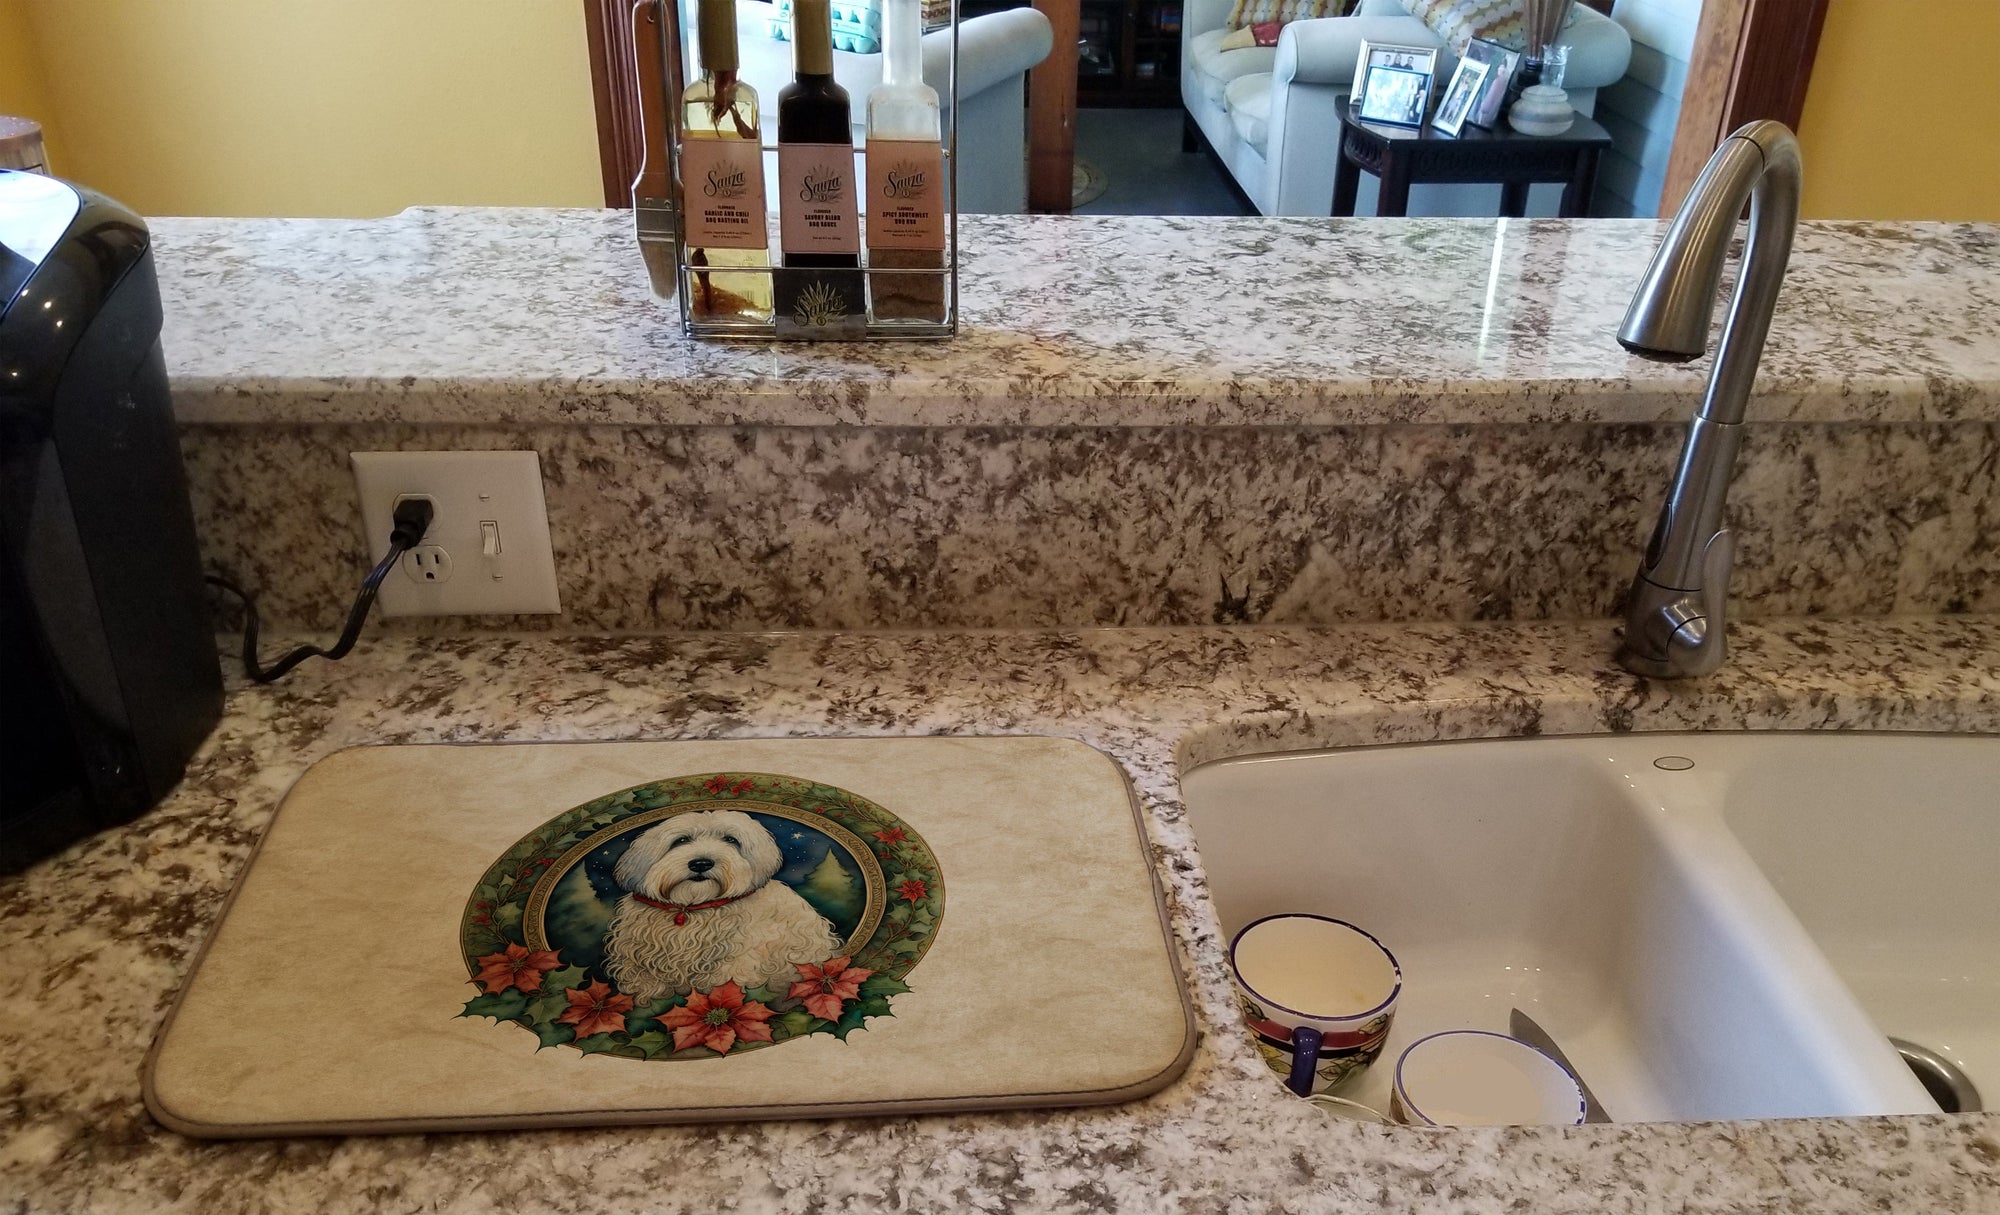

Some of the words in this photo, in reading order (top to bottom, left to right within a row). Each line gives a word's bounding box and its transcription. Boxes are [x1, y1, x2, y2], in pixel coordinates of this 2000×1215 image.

[704, 170, 745, 197] Sauza
[800, 175, 841, 202] Sauza
[883, 171, 925, 198] Sauza
